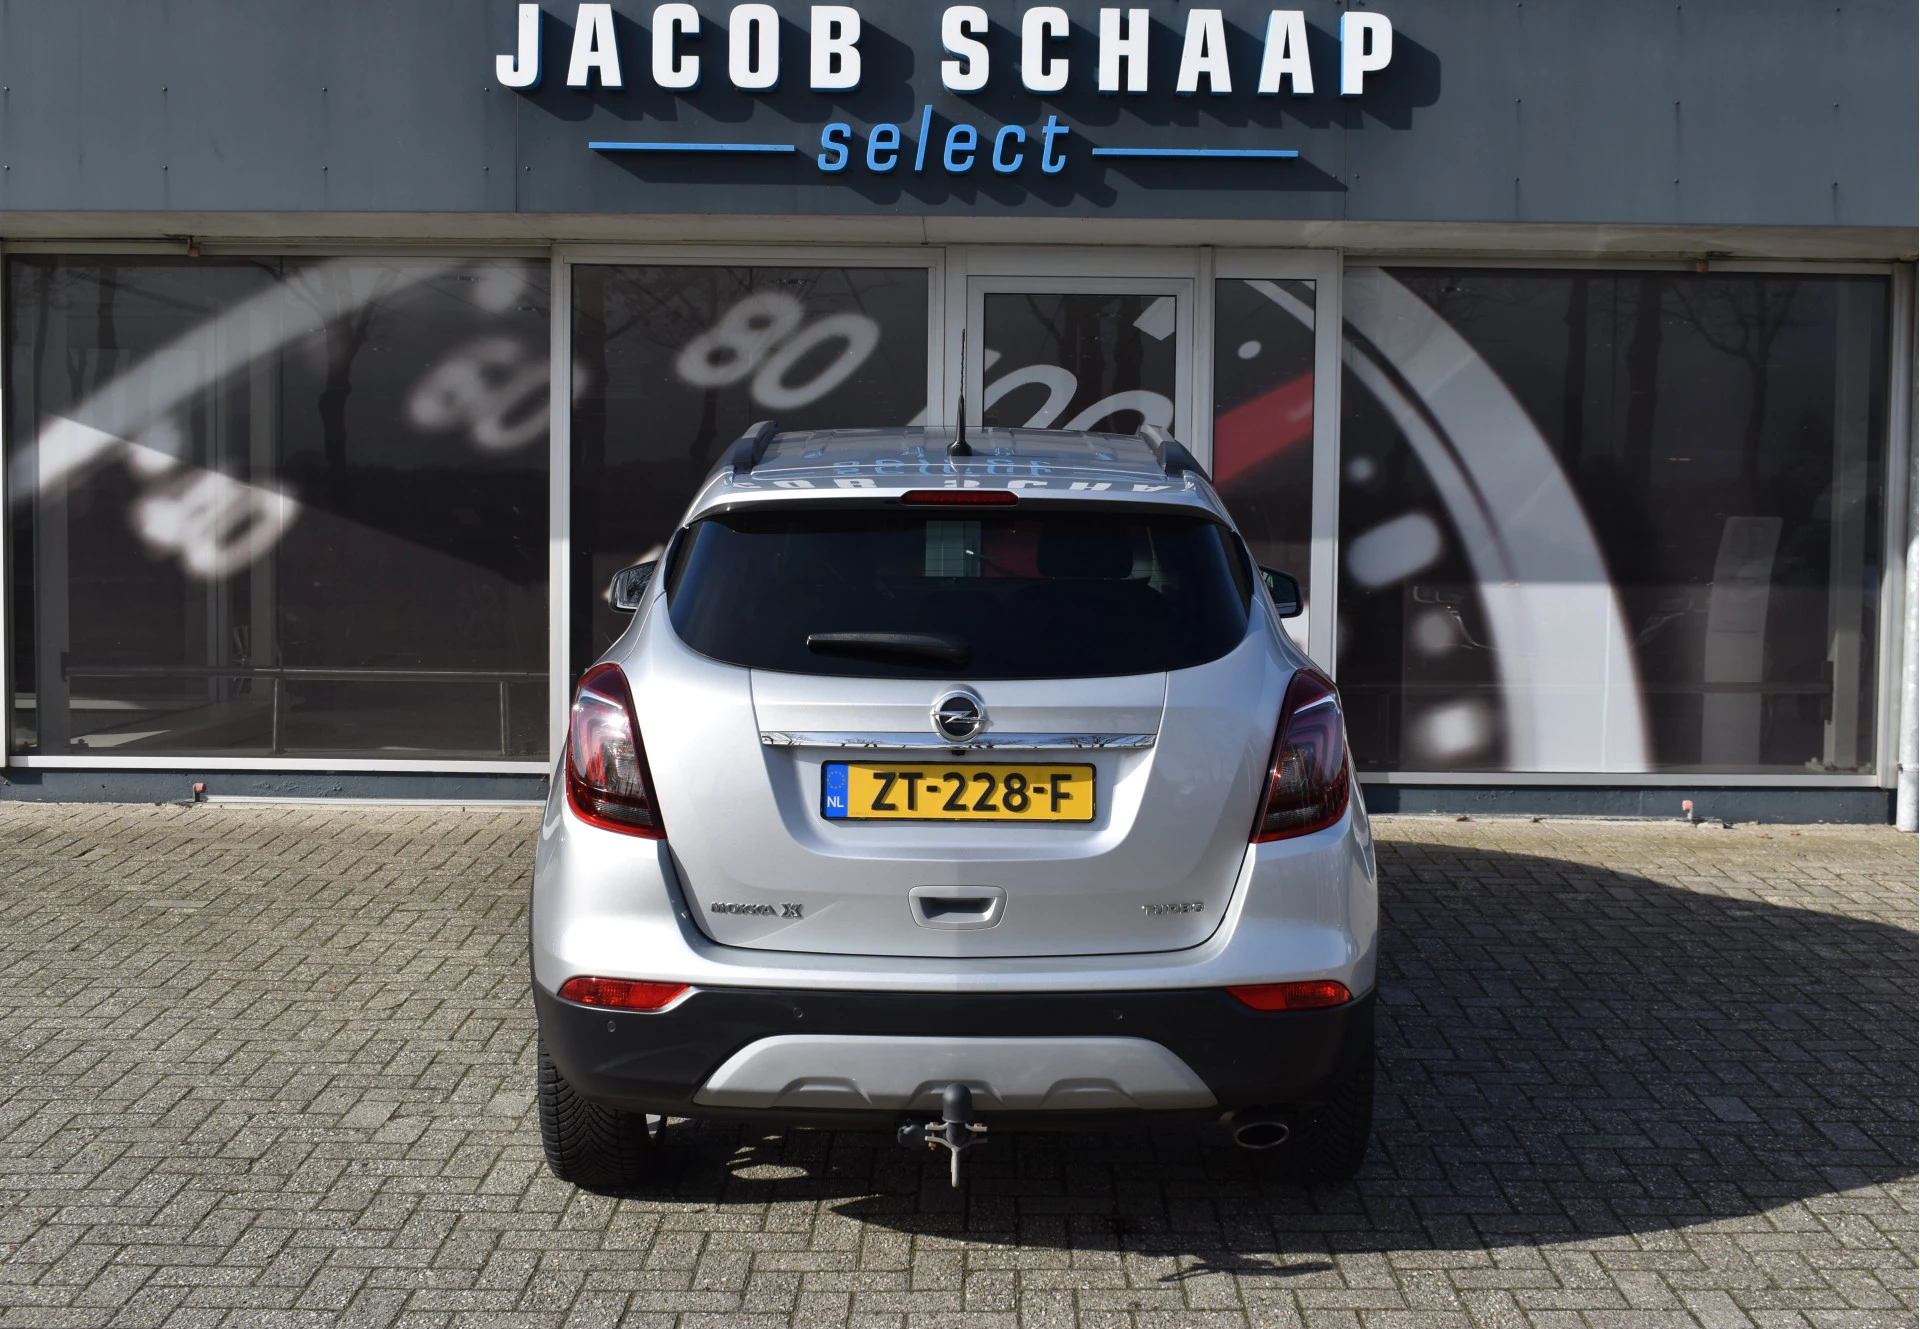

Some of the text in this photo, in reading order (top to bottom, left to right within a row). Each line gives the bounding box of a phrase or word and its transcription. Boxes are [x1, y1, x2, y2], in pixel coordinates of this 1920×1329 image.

[495, 2, 1394, 96] JACOB SCHAAP
[816, 104, 1071, 174] select
[676, 291, 880, 410] 80
[827, 796, 845, 808] NL
[871, 772, 1073, 812] ZT-228-F
[711, 902, 804, 919] MOKKA X
[1141, 902, 1205, 916] TURBO
